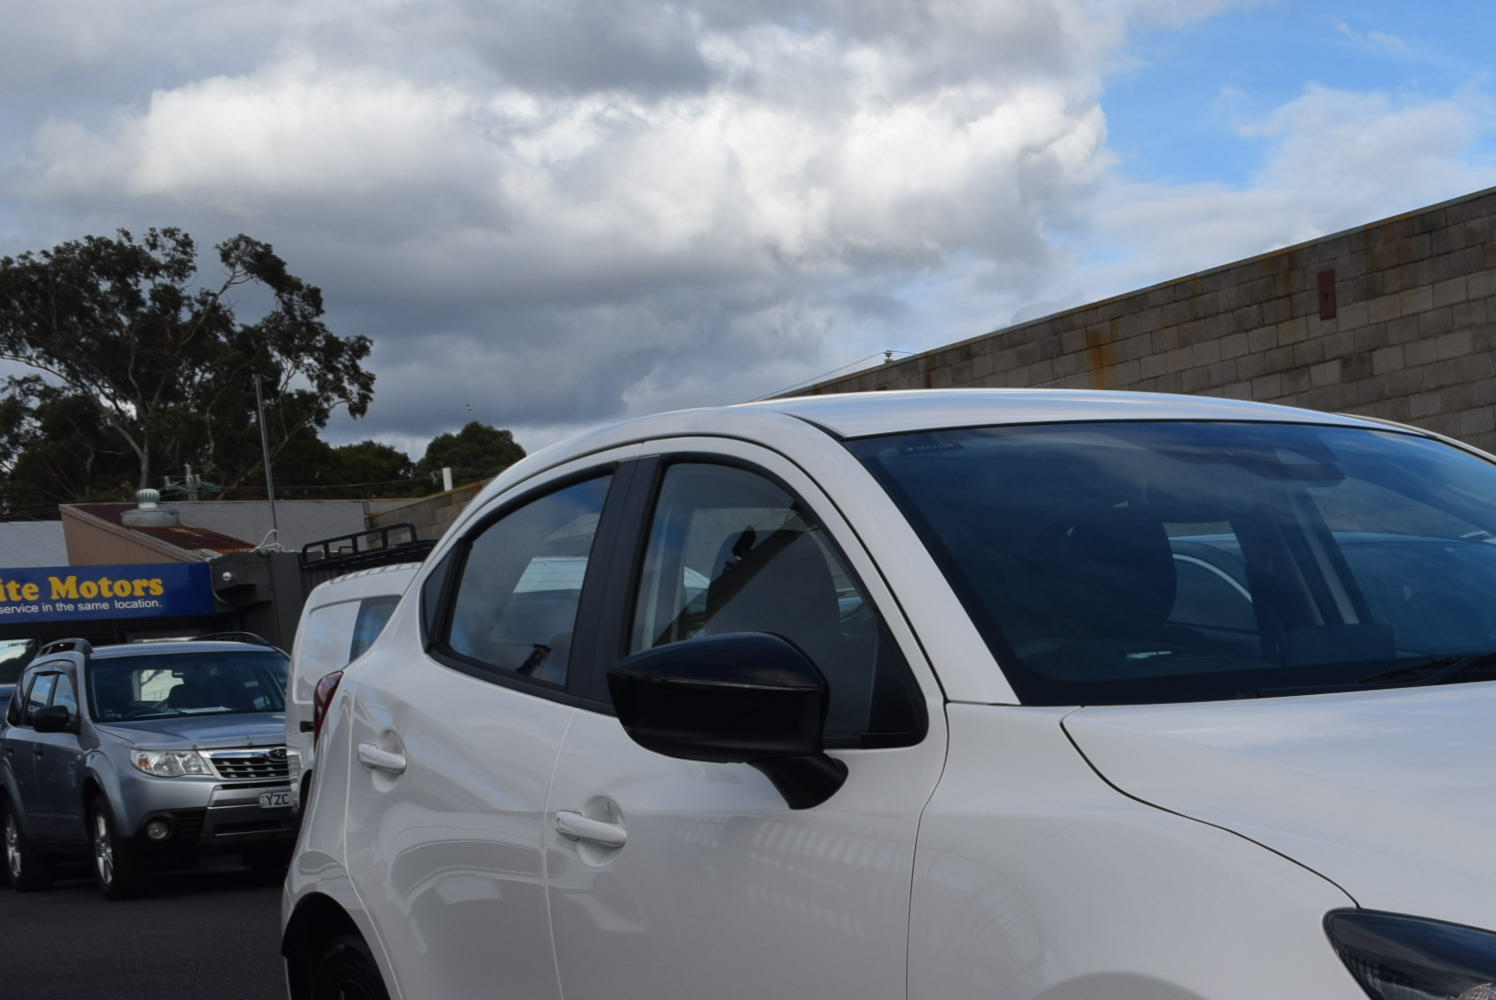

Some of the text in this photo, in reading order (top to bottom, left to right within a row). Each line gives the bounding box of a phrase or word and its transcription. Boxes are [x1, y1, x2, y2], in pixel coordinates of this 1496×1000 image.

[48, 575, 164, 600] Motors
[42, 602, 53, 612] in
[56, 601, 75, 612] the
[78, 602, 110, 611] same
[114, 598, 163, 610] location.
